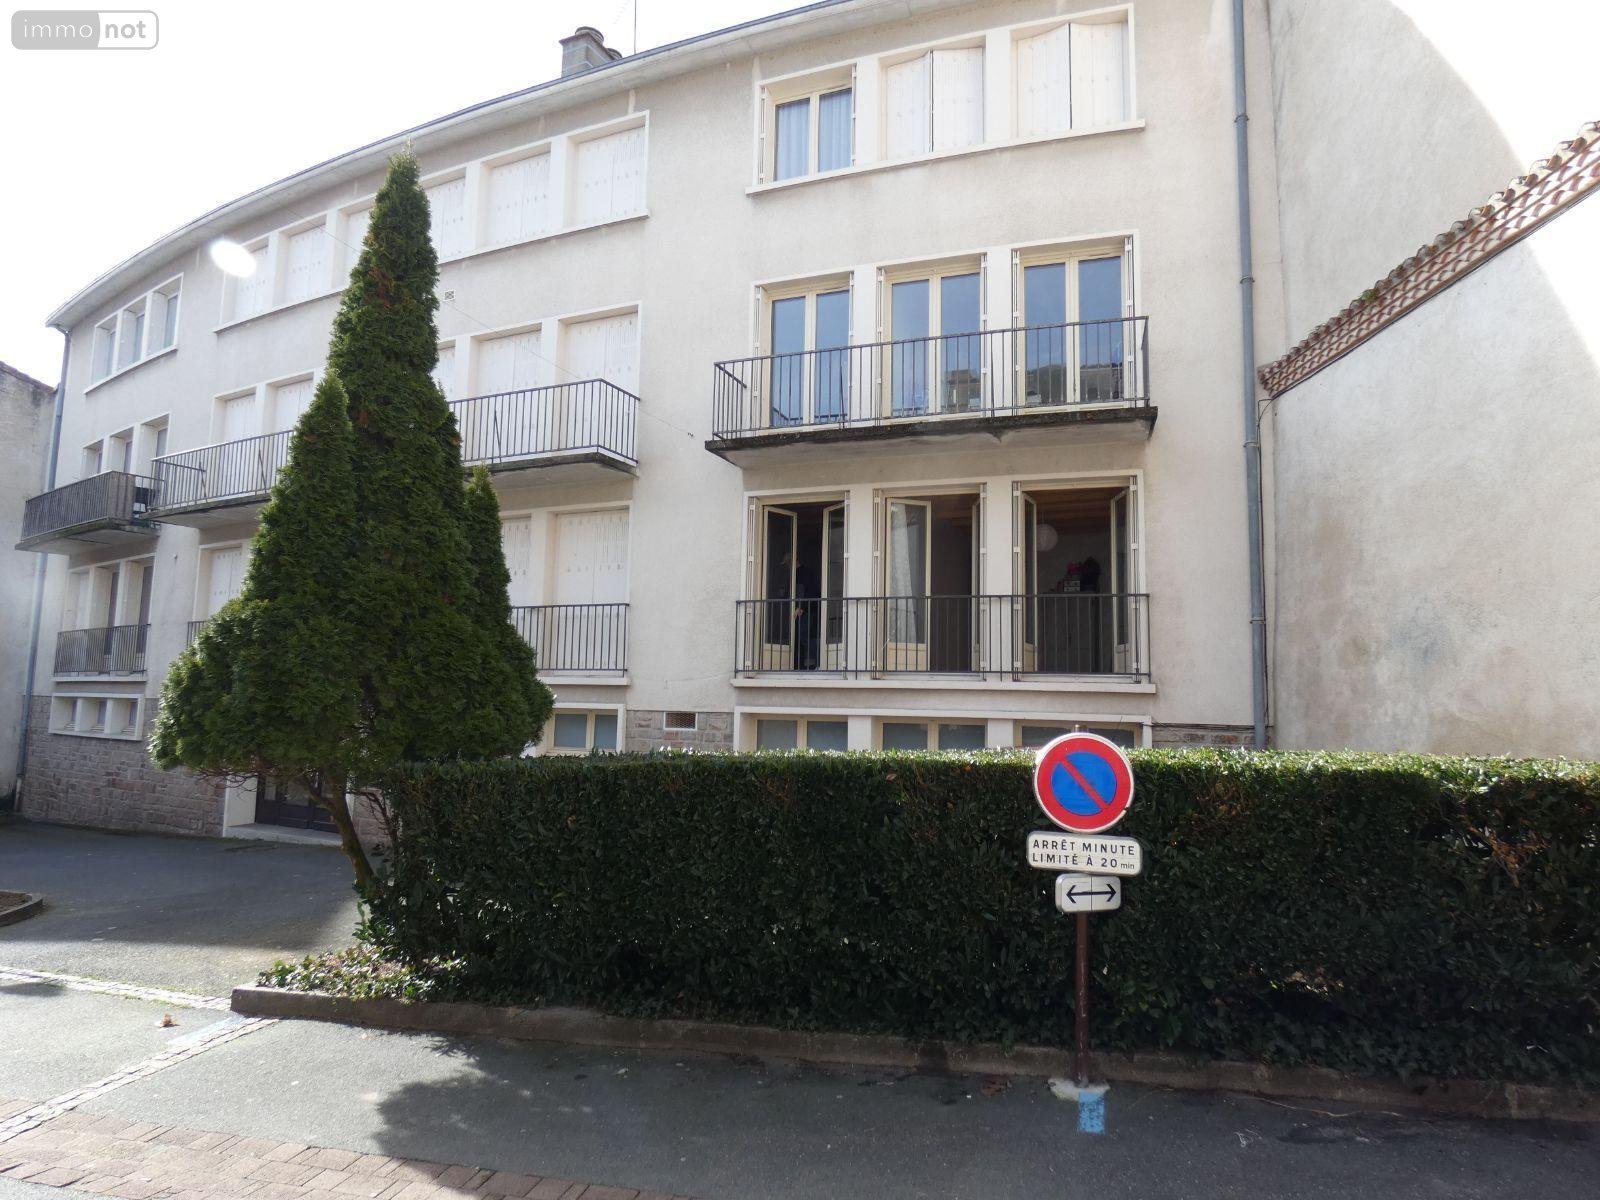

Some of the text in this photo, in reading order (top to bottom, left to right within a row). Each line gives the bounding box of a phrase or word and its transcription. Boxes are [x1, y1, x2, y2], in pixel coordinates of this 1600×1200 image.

[1033, 839, 1135, 855] ARRÊT MINUTE
[1032, 853, 1135, 869] LIMITÉ À 20 min
